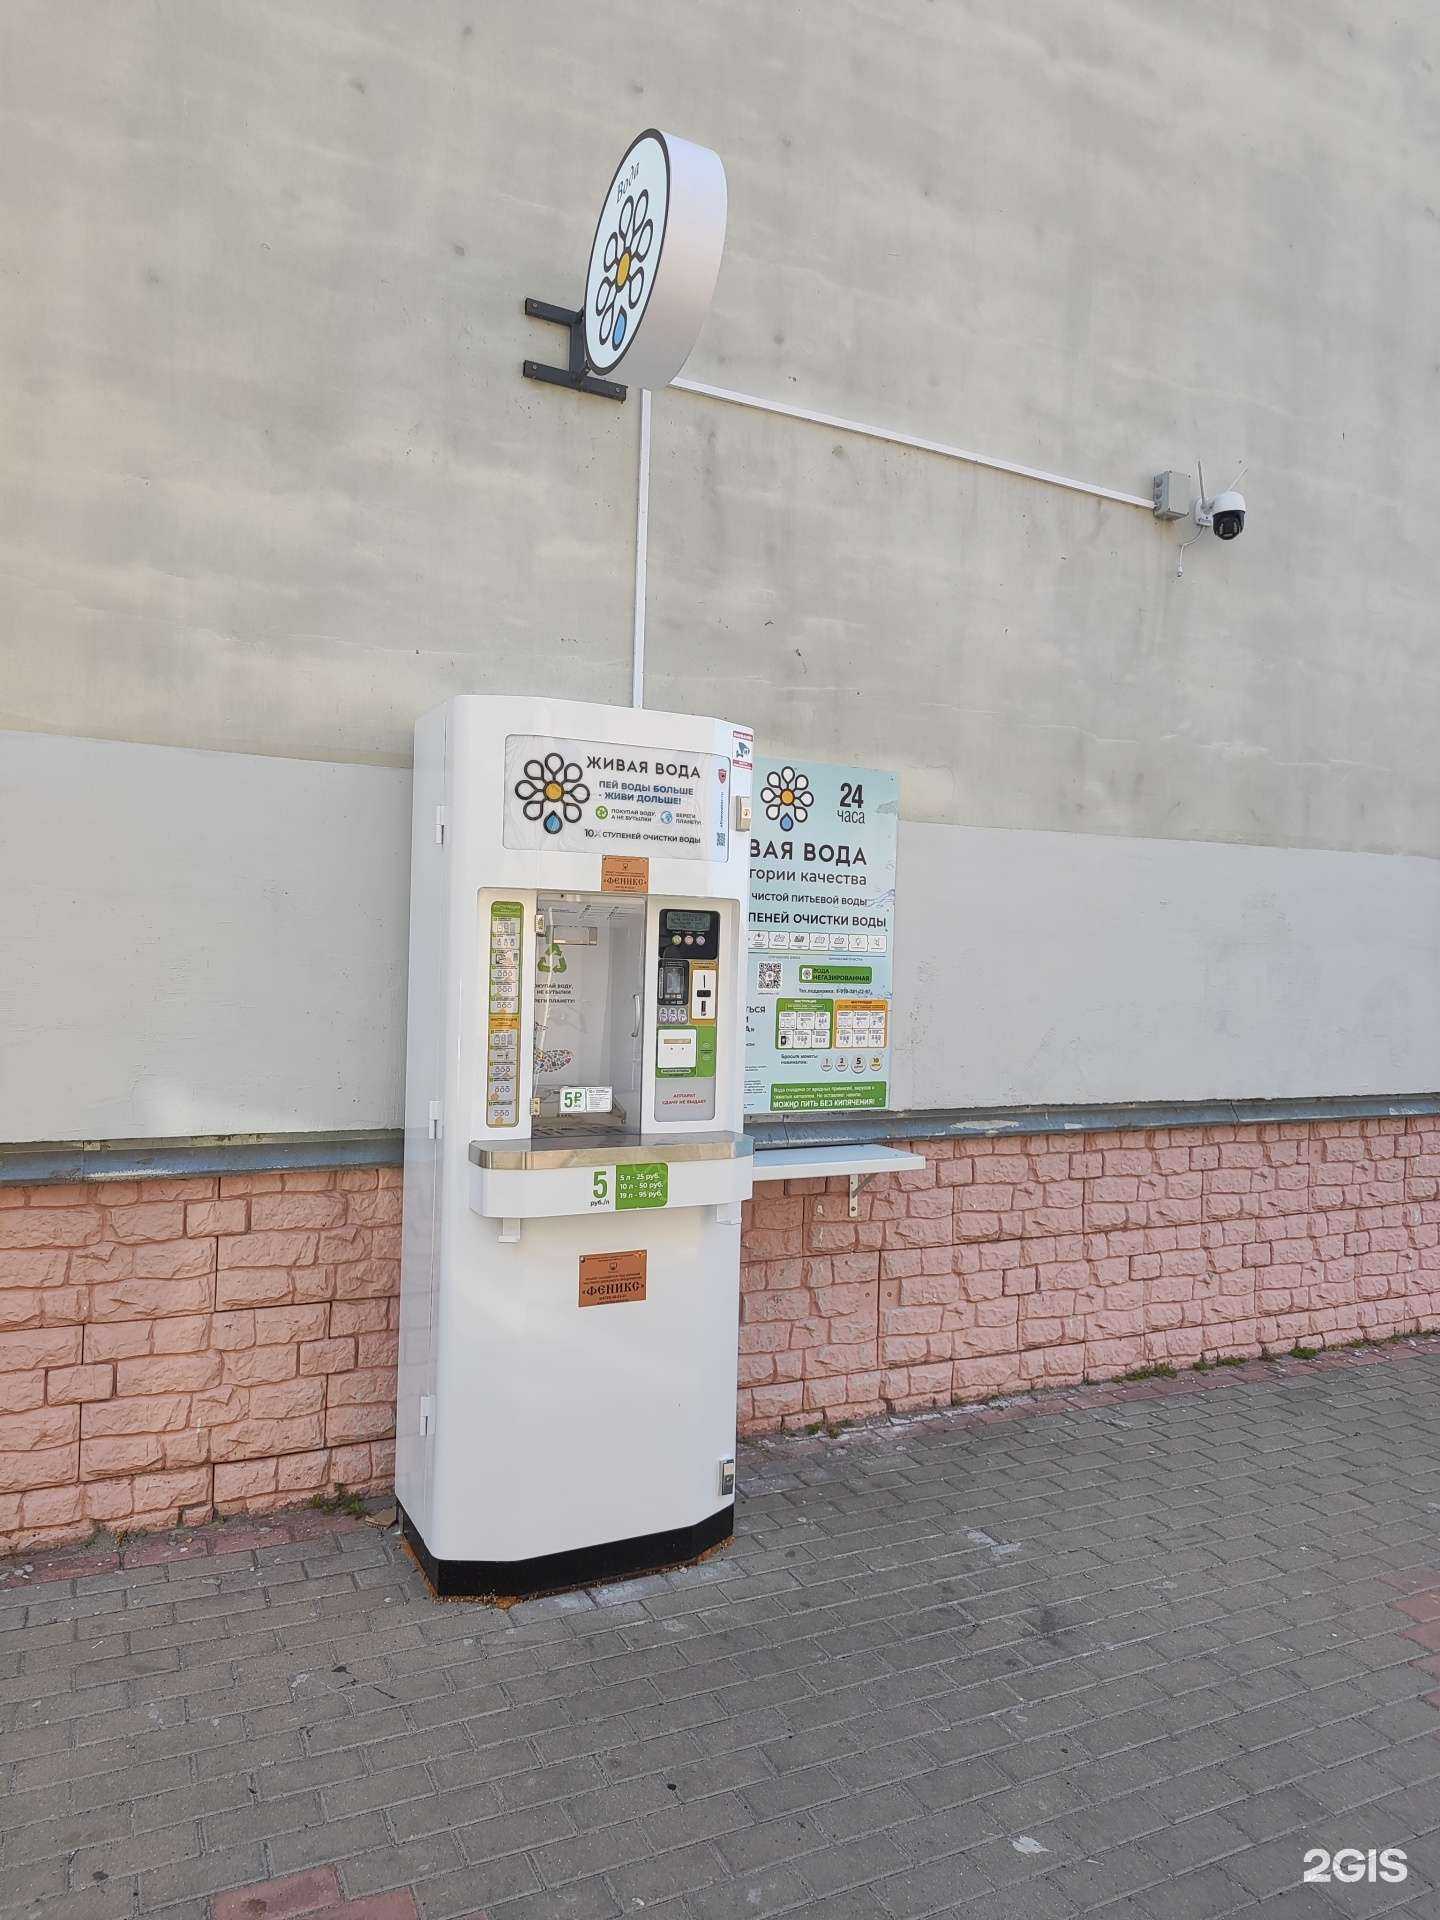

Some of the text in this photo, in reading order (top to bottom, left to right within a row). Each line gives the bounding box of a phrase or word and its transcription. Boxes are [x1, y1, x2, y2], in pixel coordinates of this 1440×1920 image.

[586, 755, 701, 780] ЖИВАЯ ВОДА
[599, 780, 694, 796] ПЕЙ ВОДЫ БОЛЬШЕ
[604, 792, 634, 801] ЖИВИ
[636, 794, 682, 805] ДОЛЬШЕ!
[839, 782, 864, 809] 24
[611, 808, 639, 816] ПОКУПАЙ
[836, 809, 866, 825] часа
[602, 831, 641, 841] СТУПЕНЕЙ
[642, 834, 678, 843] ОЧИСТКИ
[679, 836, 701, 845] ВОДЫ
[803, 842, 867, 868] ВОДА
[800, 871, 867, 887] качества
[793, 914, 850, 926] ОЧИСТКИ
[852, 916, 887, 929] ВОДЫ
[856, 1057, 863, 1065] 5
[773, 1101, 799, 1109] МОЖНО
[645, 1173, 660, 1181] руб.
[593, 1171, 607, 1198] 5
[649, 1181, 664, 1189] руб.
[648, 1190, 662, 1198] руб.
[590, 1199, 610, 1207] руб./л
